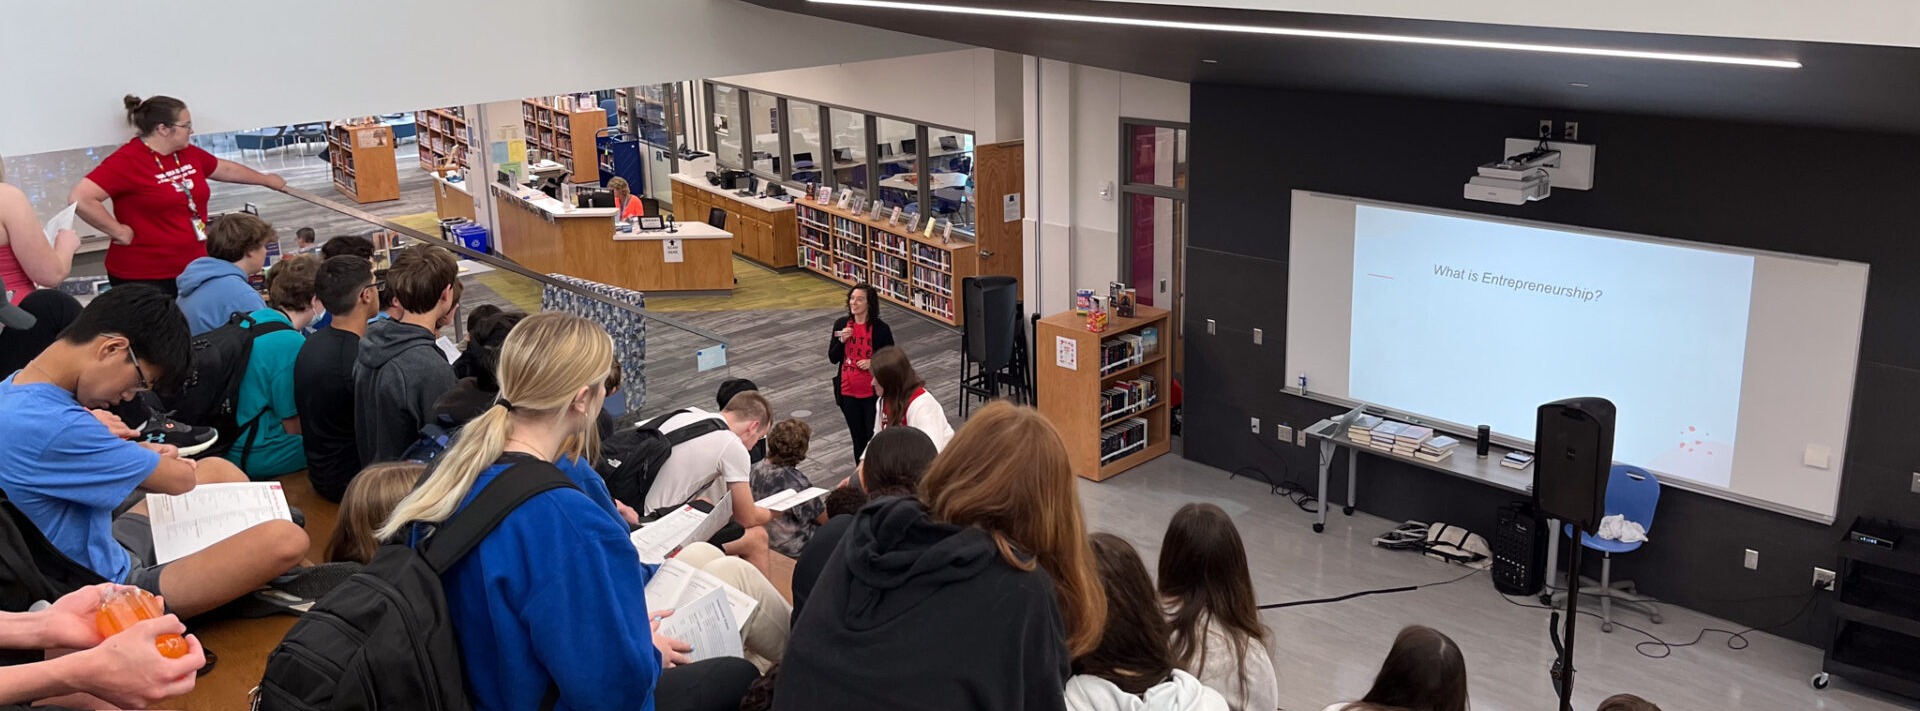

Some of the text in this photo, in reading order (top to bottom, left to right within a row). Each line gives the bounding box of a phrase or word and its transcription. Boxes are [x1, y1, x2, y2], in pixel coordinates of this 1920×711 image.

[1434, 264, 1603, 302] What is Entrepreneurship?
